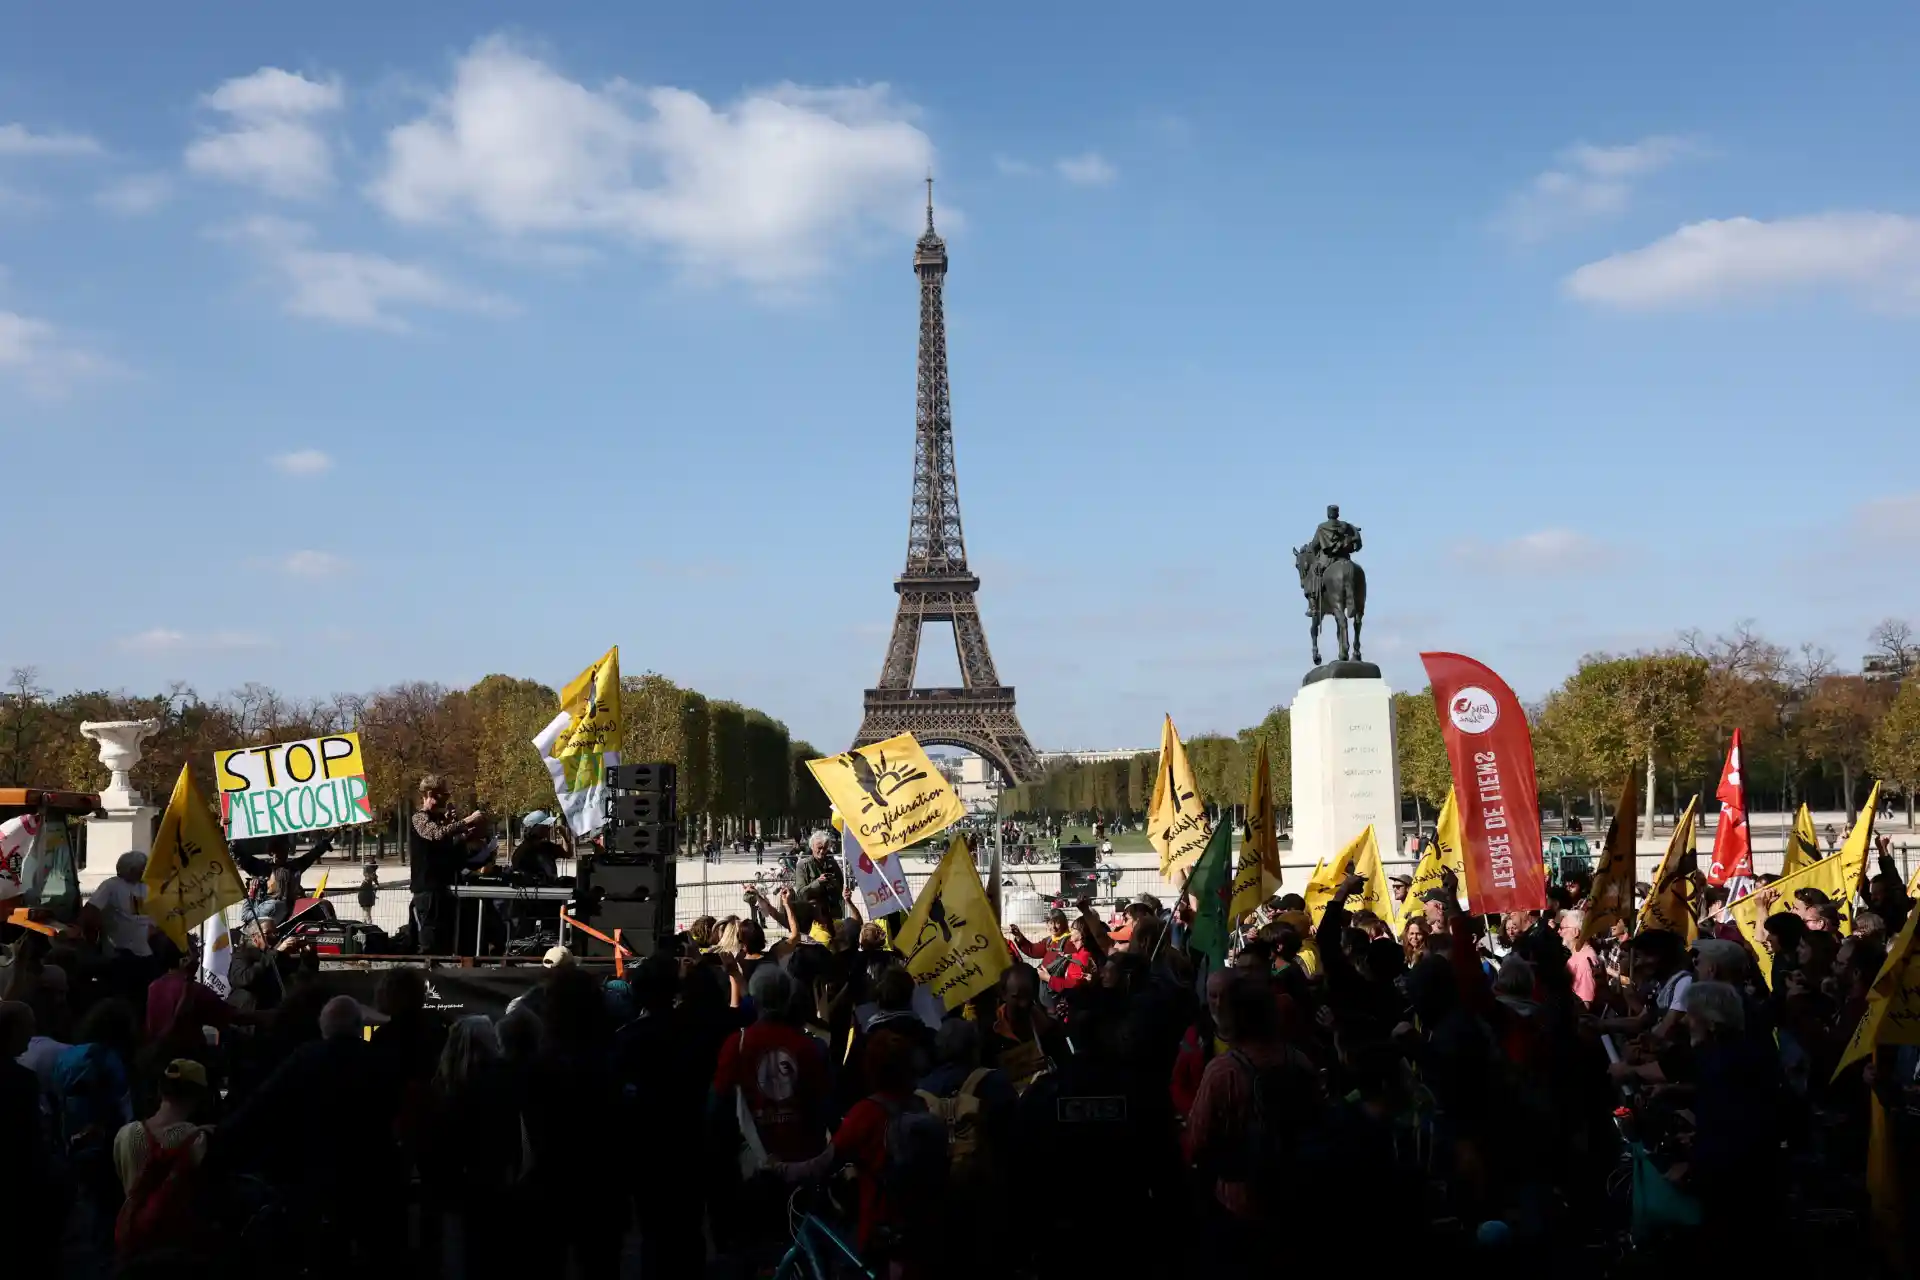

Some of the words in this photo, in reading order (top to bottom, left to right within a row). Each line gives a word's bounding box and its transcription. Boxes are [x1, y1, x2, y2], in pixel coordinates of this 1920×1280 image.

[224, 737, 354, 793] STOP
[226, 775, 373, 838] MERCOSUR
[860, 788, 943, 837] Confédération
[880, 809, 941, 847] Paysanne
